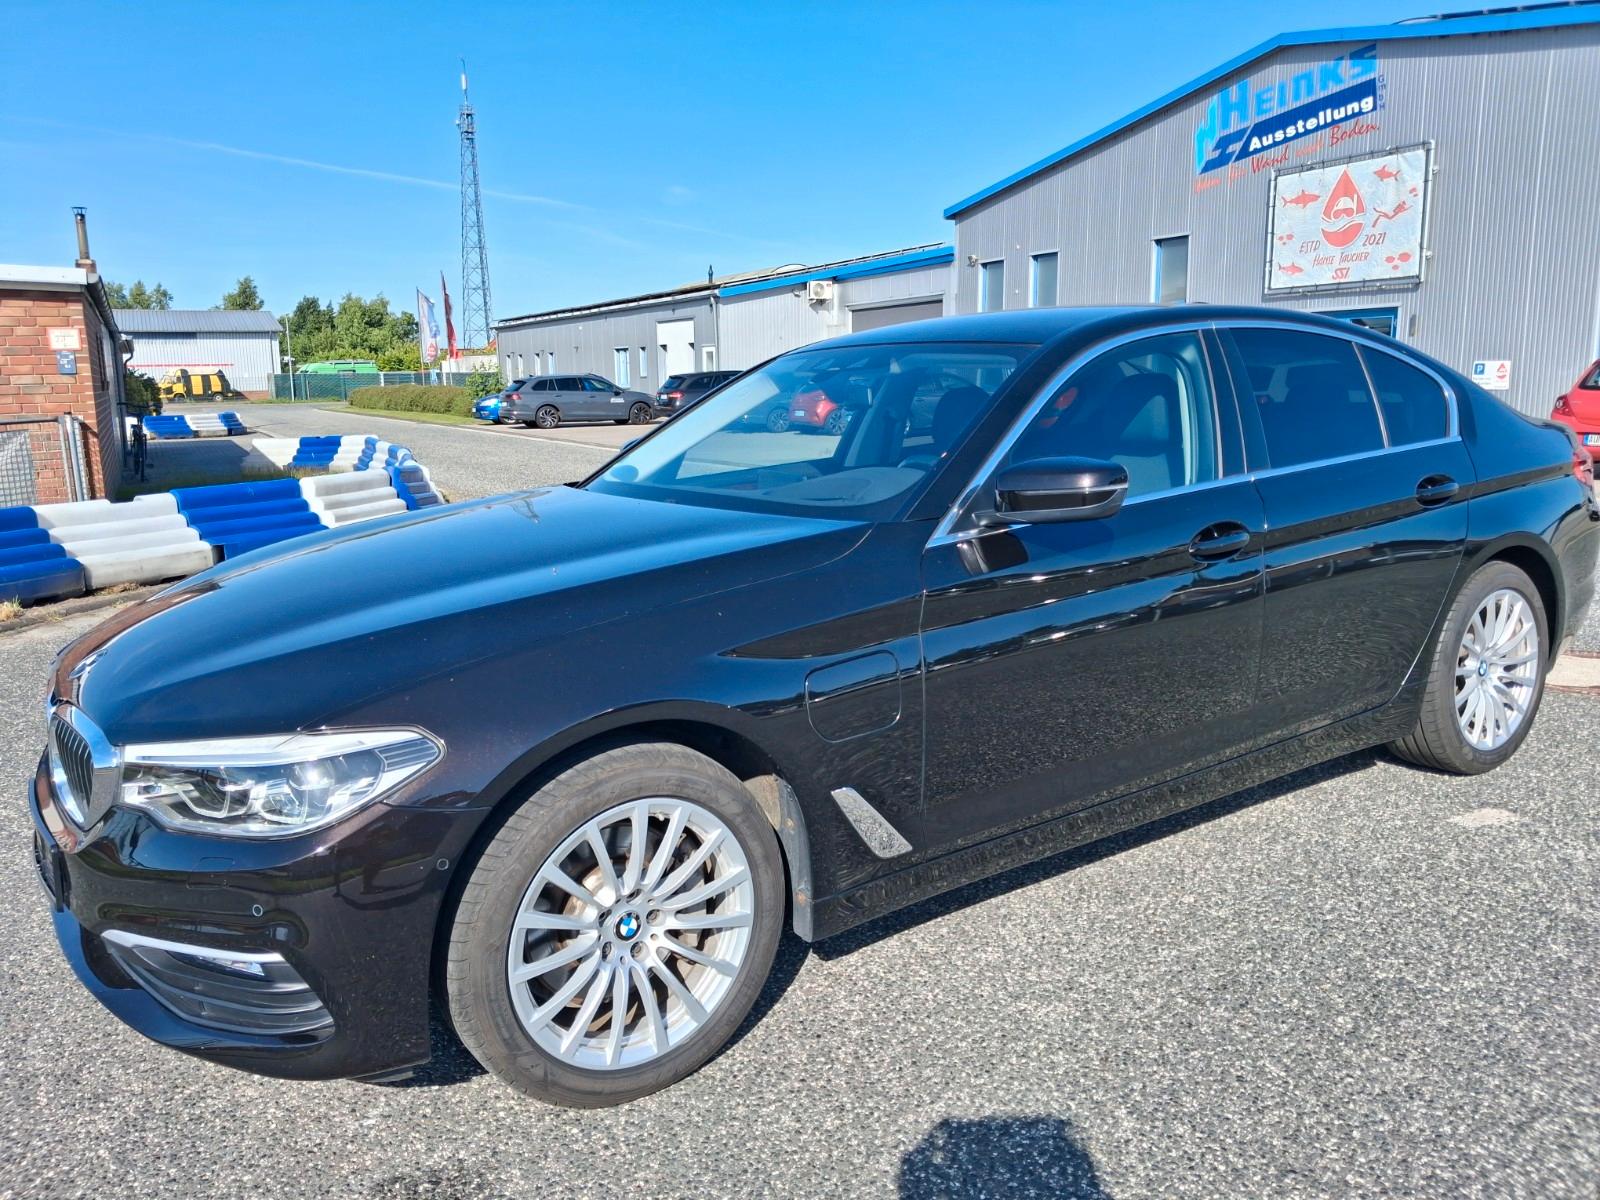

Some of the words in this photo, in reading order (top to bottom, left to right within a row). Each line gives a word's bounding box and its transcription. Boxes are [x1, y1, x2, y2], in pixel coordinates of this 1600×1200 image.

[1249, 96, 1374, 152] Ausstellung
[1251, 144, 1289, 175] Wand
[1299, 240, 1321, 254] ESTD
[1362, 232, 1387, 247] 2021
[1332, 267, 1351, 280] SSI
